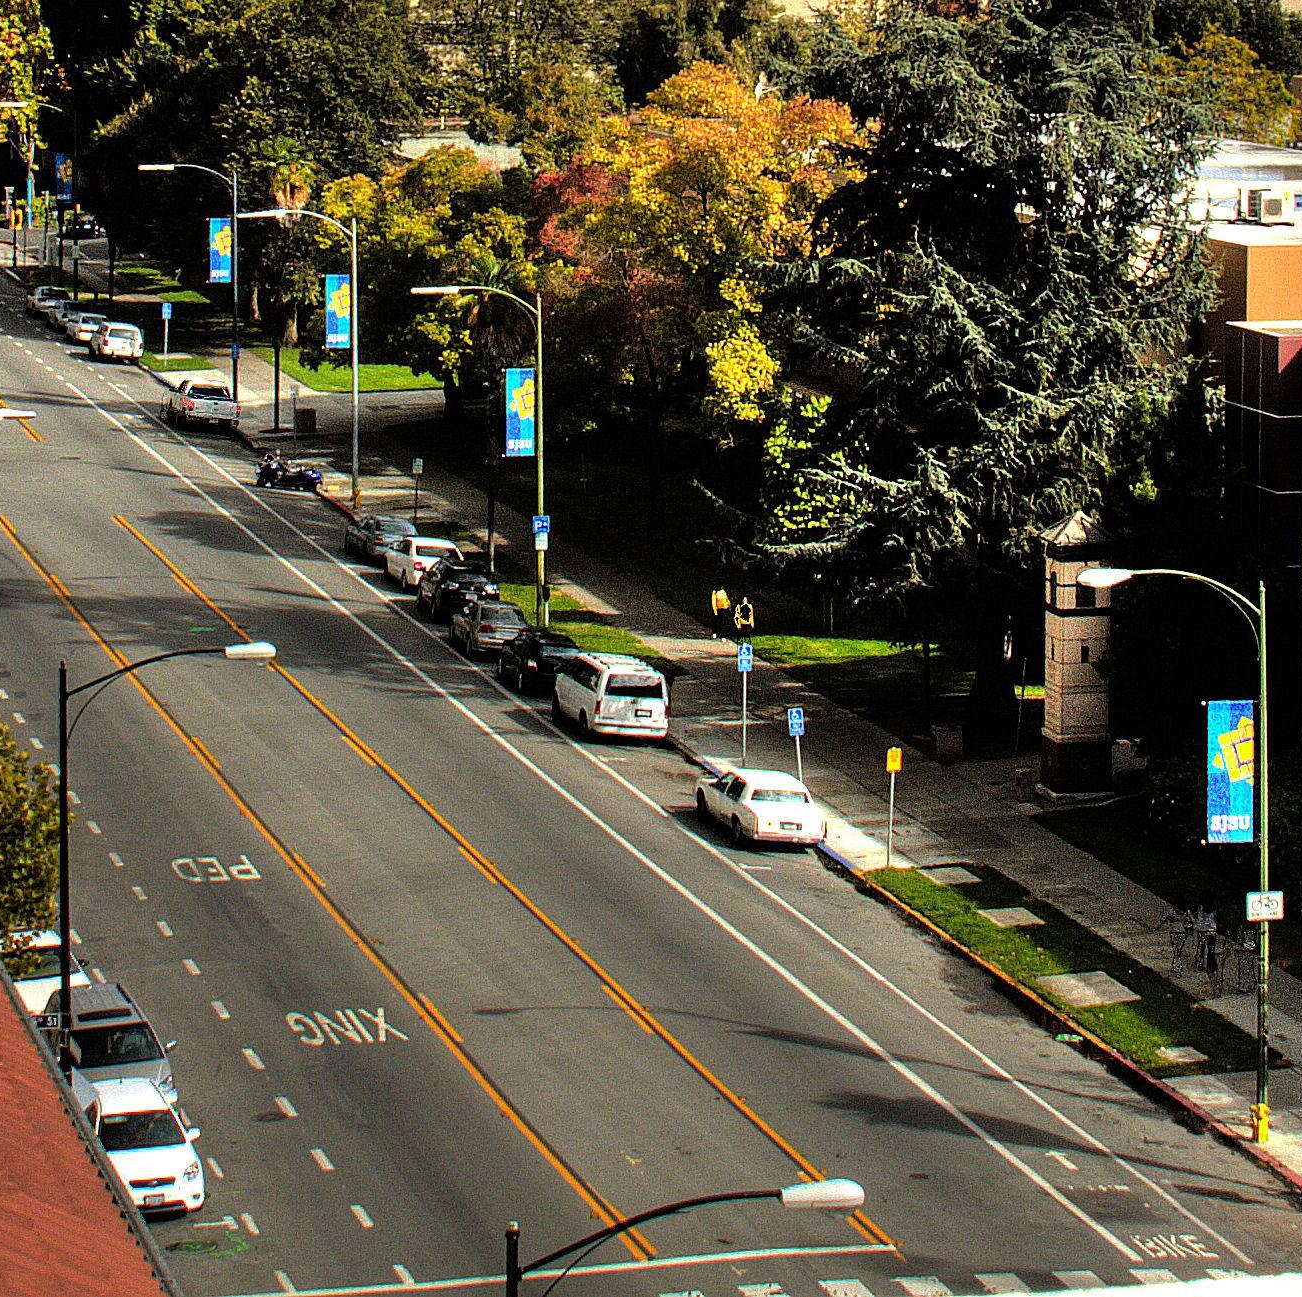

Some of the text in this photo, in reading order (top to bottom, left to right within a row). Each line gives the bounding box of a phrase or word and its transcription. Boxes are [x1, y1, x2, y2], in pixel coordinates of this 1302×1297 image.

[171, 854, 262, 883] PED
[285, 1007, 410, 1047] XING
[1130, 1234, 1220, 1260] BIKE
